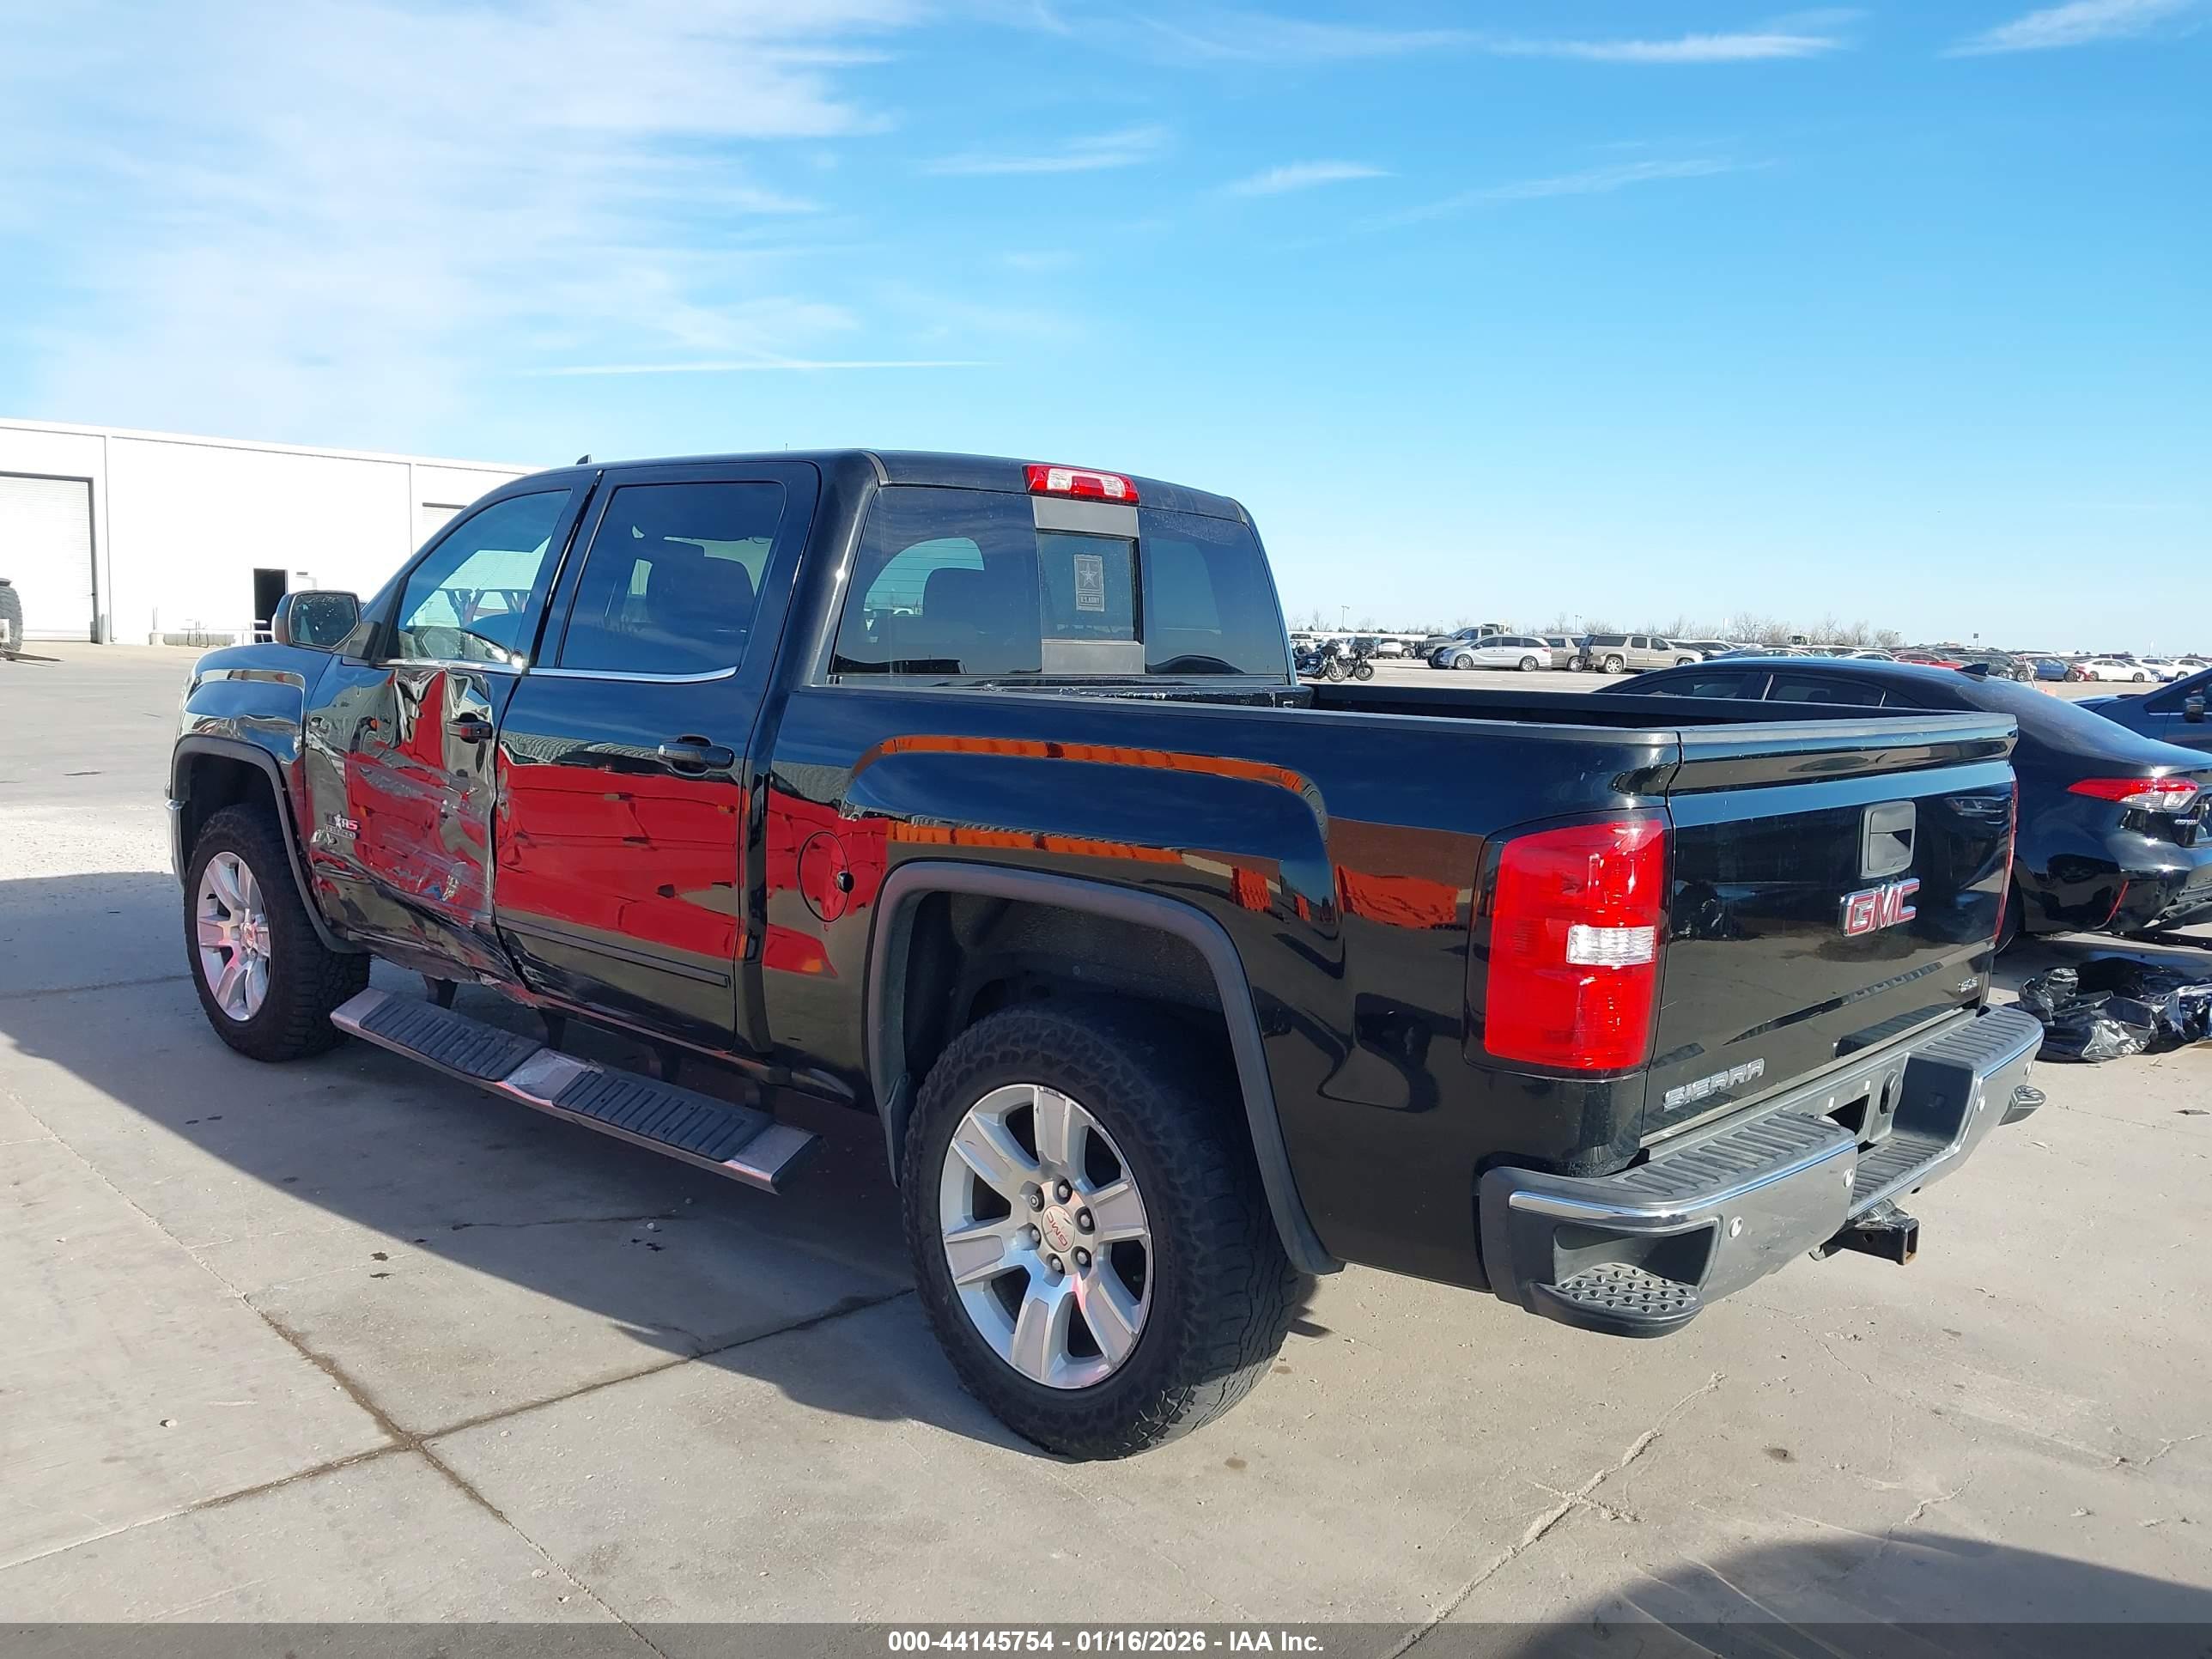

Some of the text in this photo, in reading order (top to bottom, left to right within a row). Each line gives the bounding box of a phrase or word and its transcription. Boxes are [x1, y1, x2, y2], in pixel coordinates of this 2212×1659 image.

[1840, 878, 1920, 937] GMC
[1663, 1057, 1765, 1112] SIERRA
[1046, 1210, 1068, 1247] GMC
